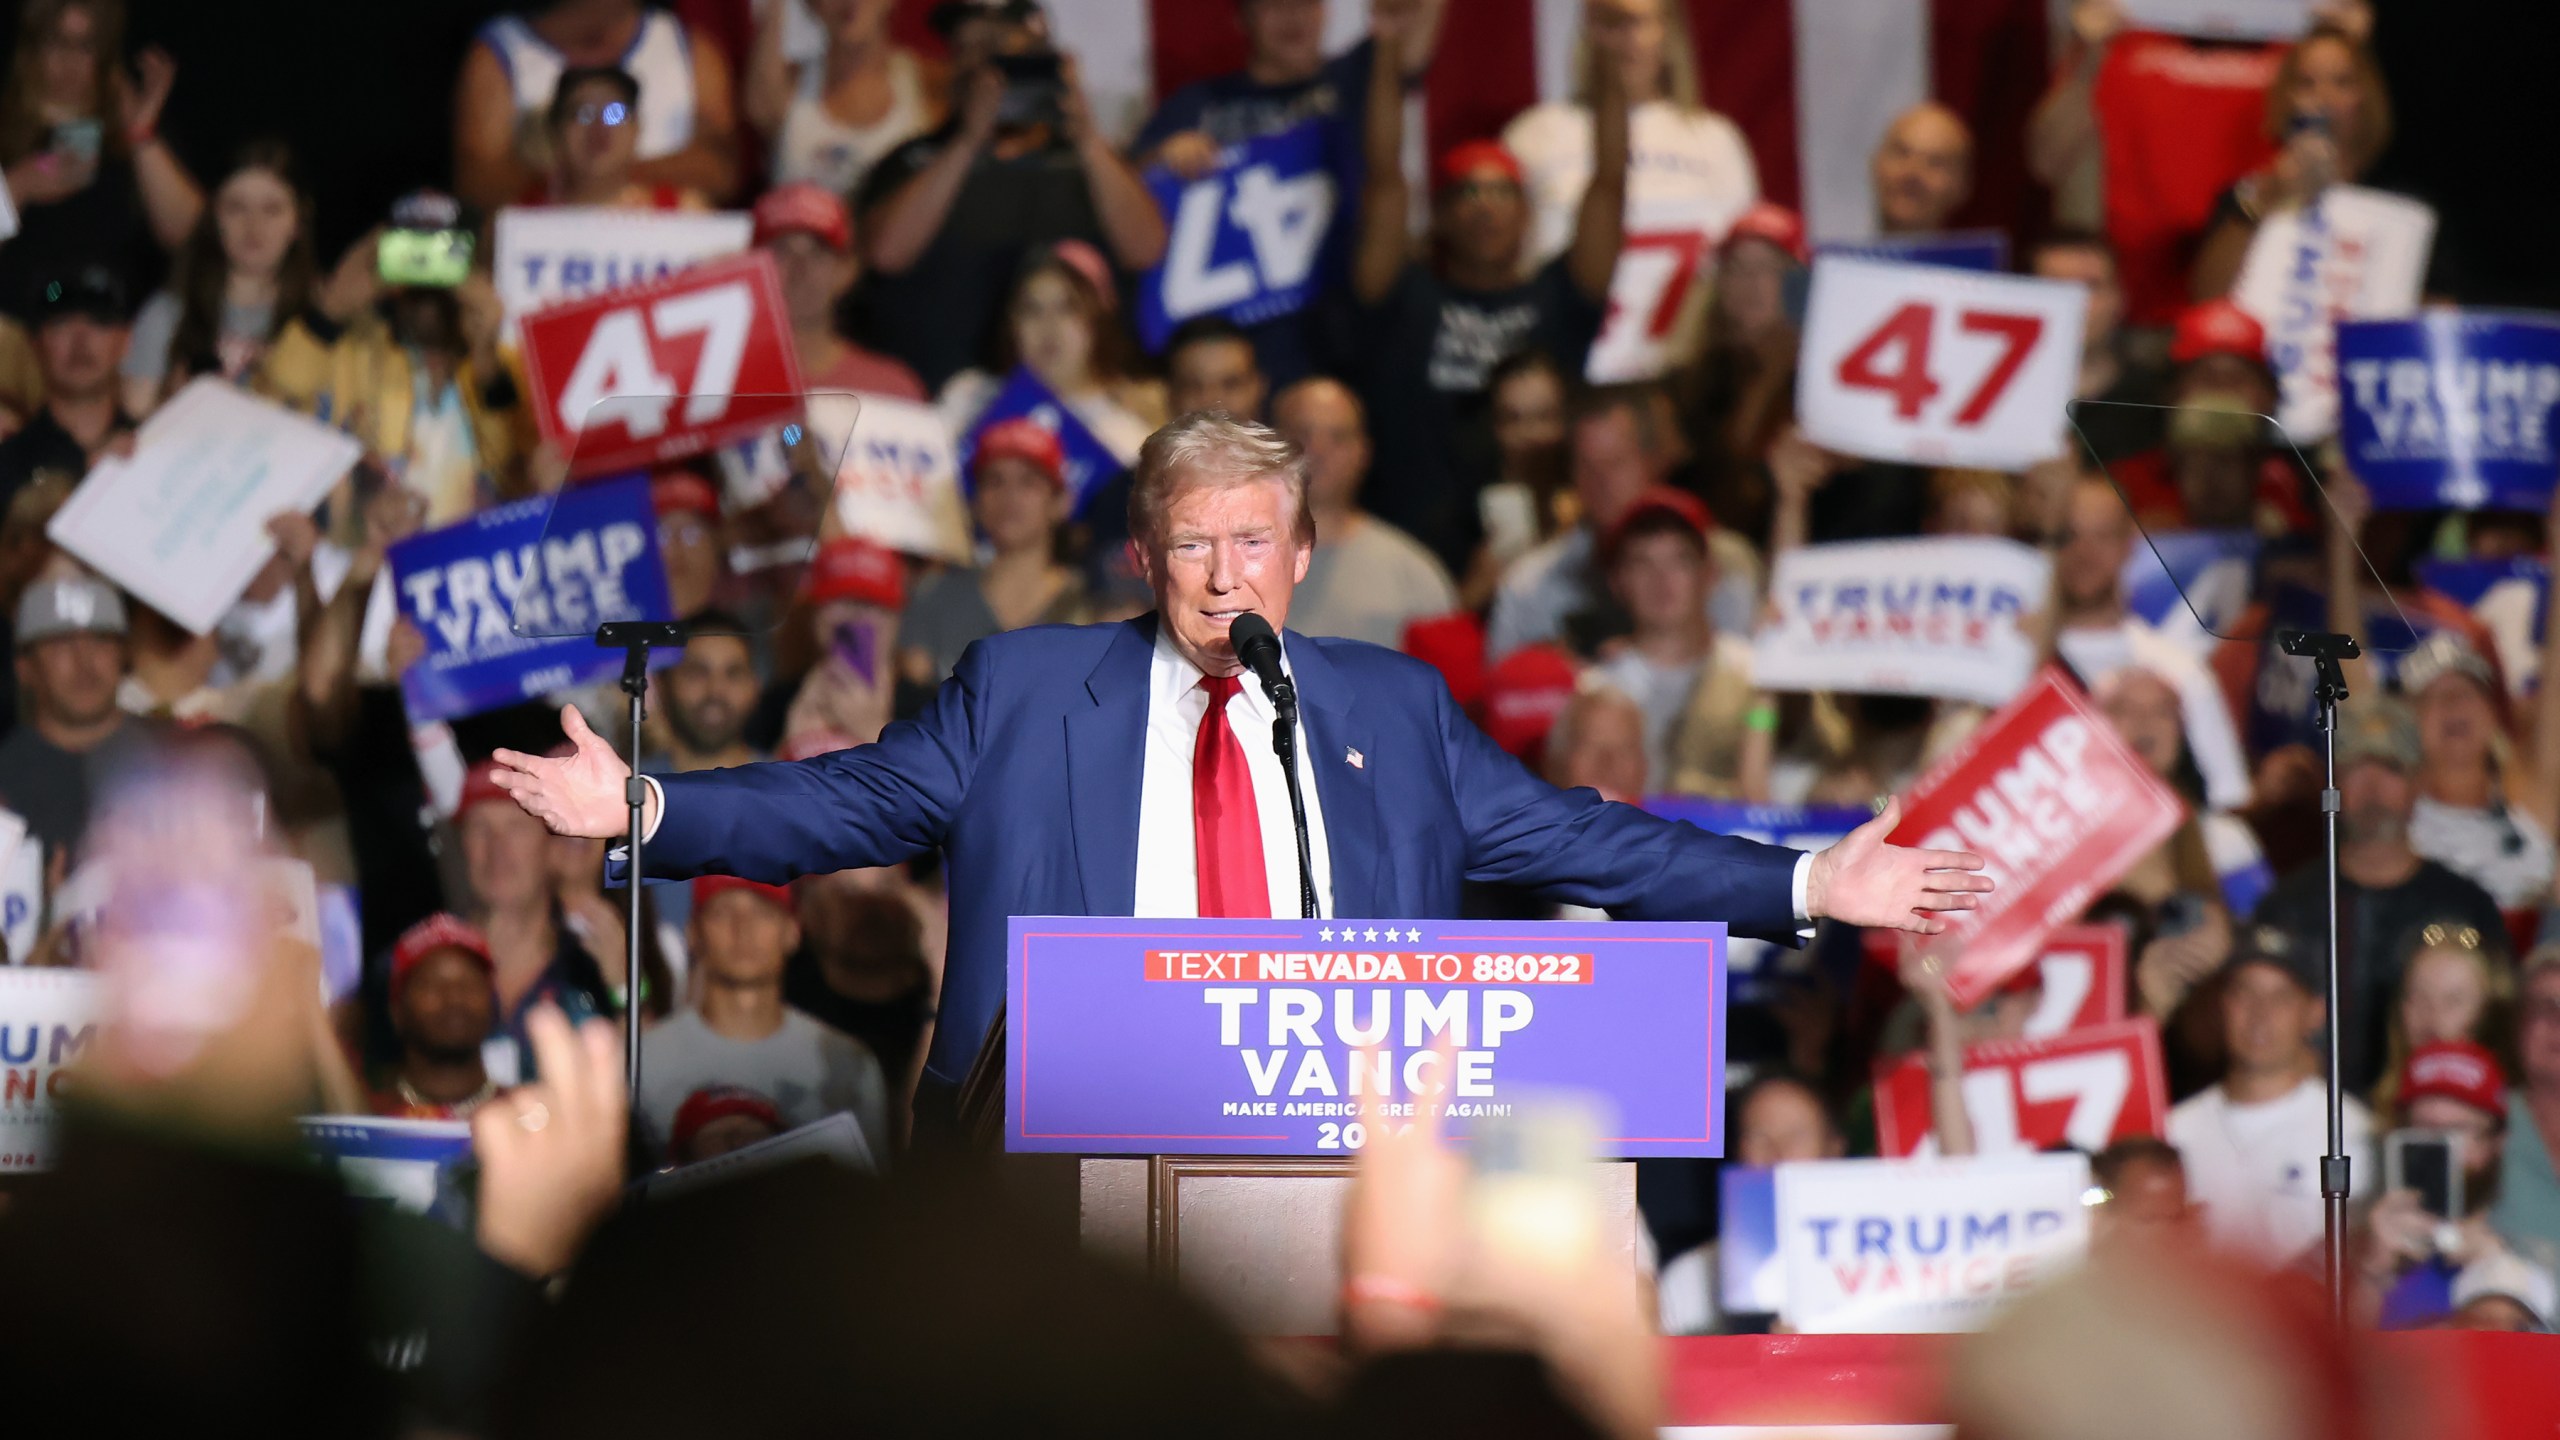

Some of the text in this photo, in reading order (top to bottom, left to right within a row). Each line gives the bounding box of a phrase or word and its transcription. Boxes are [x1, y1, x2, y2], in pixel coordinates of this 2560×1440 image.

[558, 283, 755, 440] 47
[1836, 302, 2044, 428] 47
[402, 520, 646, 624] TRUMP
[432, 562, 632, 658] VANCE
[1798, 580, 2024, 616] TRUMP
[1813, 613, 1987, 645] VANCE
[1159, 952, 1580, 983] TEXT NEVADA TO 88022
[1203, 987, 1535, 1048] TRUMP
[1239, 1049, 1495, 1098] VANCE
[1222, 1102, 1278, 1117] MAKE
[1378, 1103, 1439, 1118] GRET
[1444, 1103, 1512, 1119] AGAIN!
[1832, 1254, 2036, 1297] VANCE
